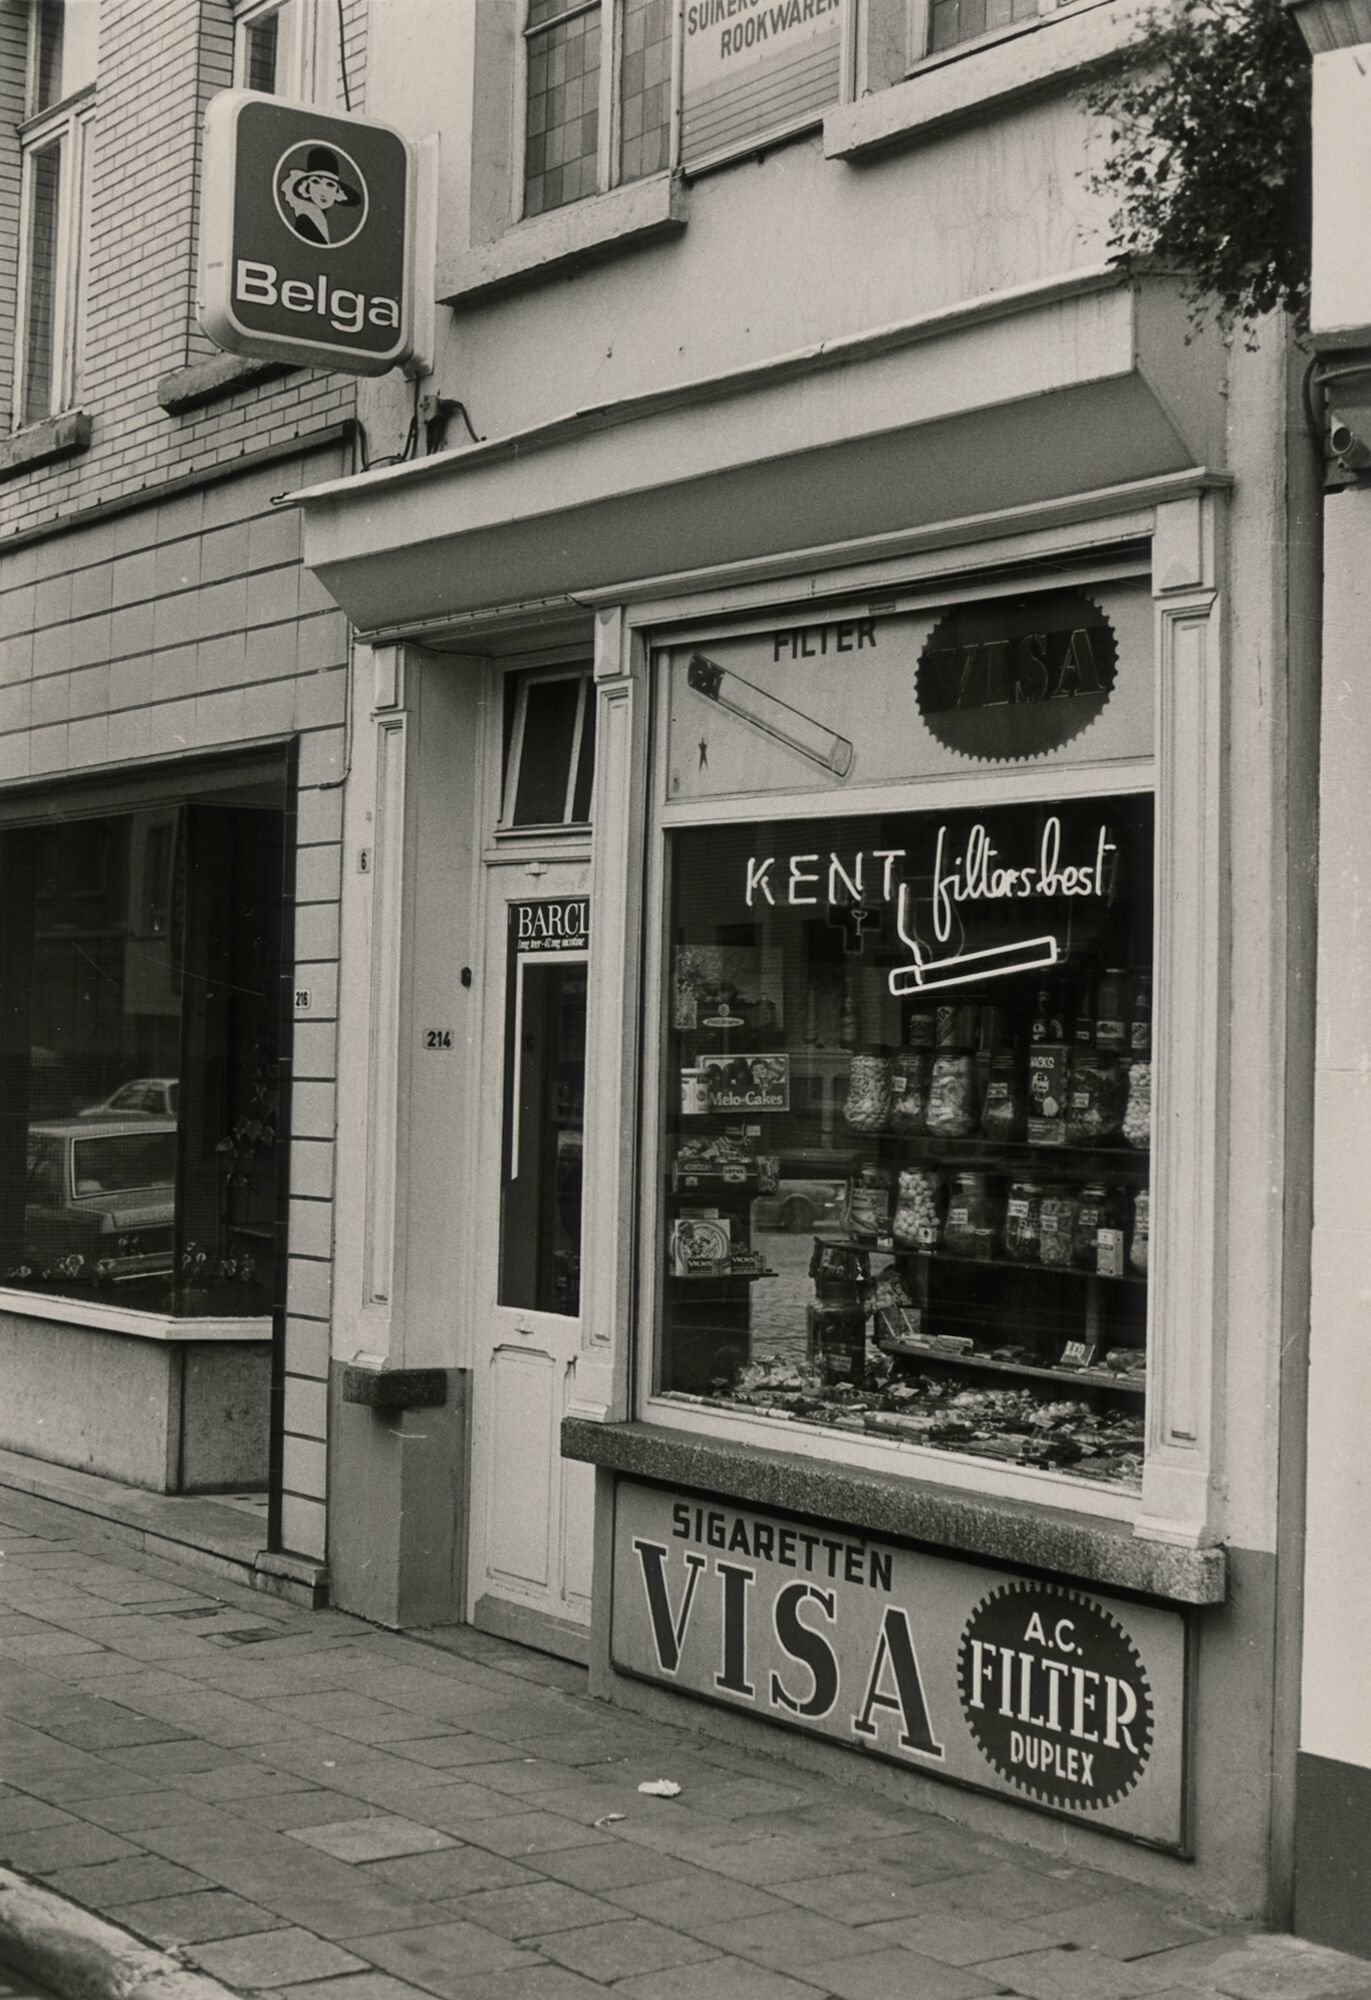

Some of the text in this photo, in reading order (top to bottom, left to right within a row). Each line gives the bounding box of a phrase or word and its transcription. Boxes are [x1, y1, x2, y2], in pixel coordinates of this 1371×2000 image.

[236, 259, 399, 333] Belga
[773, 617, 877, 663] FILTER
[927, 628, 1106, 708] VISA
[360, 852, 368, 870] 6
[746, 849, 906, 906] KENT
[427, 1031, 452, 1048] 214
[672, 1503, 893, 1592] SIGARETTEN
[633, 1536, 945, 1762] VISA
[1024, 1611, 1083, 1656] A.C.
[970, 1639, 1139, 1755] FILTER
[1010, 1730, 1094, 1787] DUPLEX
